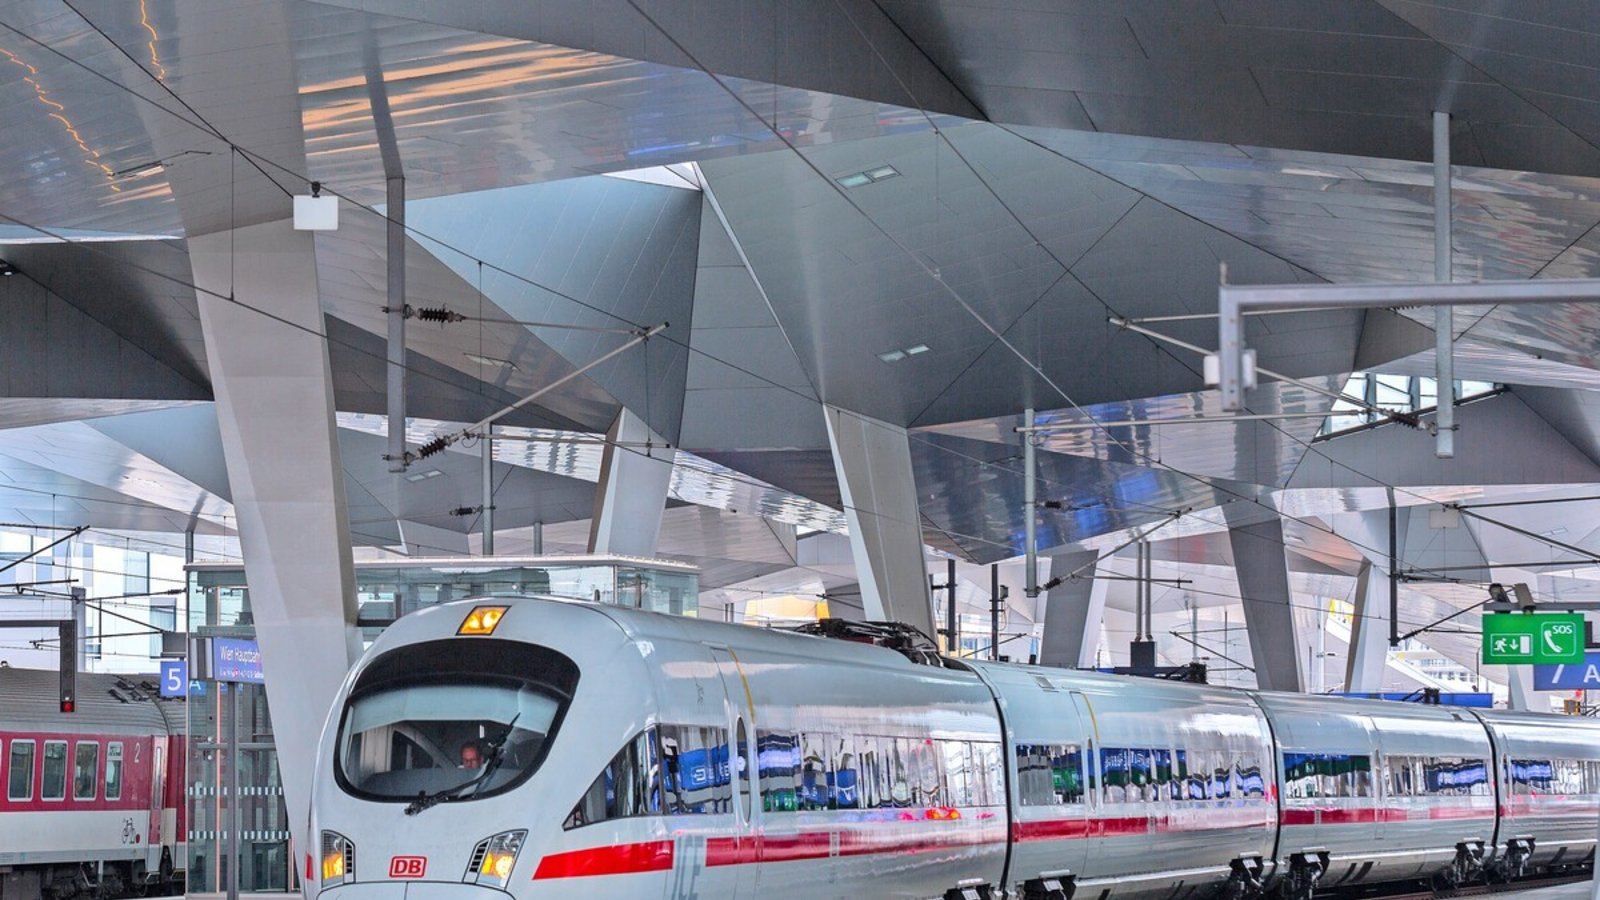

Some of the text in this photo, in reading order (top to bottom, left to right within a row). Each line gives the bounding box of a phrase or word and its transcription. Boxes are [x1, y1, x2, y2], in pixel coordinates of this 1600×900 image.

[1552, 625, 1573, 635] SOS
[220, 646, 234, 661] Wien
[167, 668, 181, 691] 5
[1583, 664, 1600, 683] A
[134, 742, 141, 763] 2
[393, 859, 422, 875] DB
